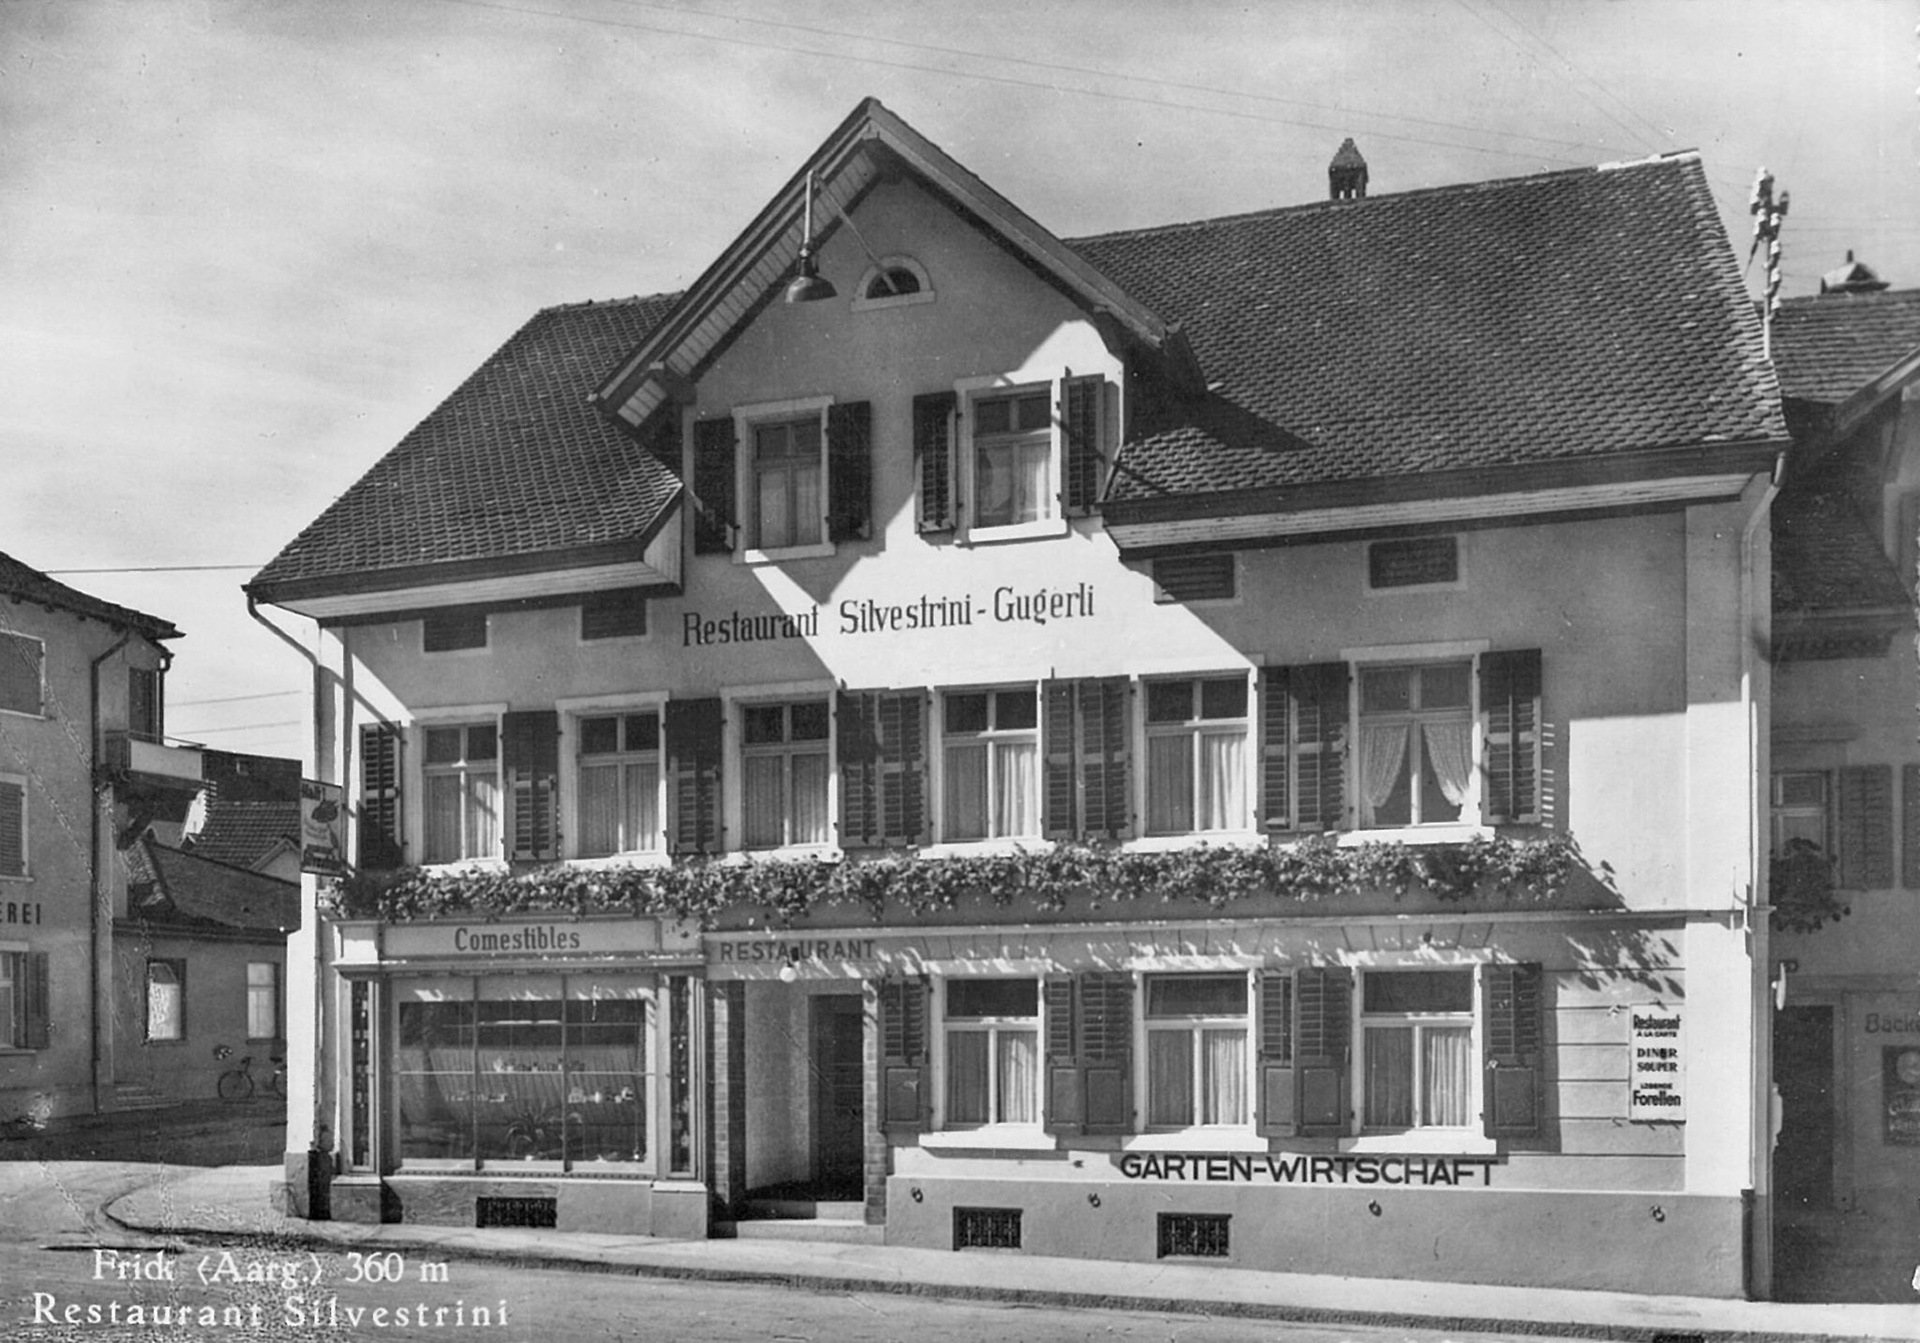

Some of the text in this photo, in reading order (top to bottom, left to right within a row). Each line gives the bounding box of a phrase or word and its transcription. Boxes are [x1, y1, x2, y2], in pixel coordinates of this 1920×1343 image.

[682, 603, 819, 647] Restaurant
[0, 902, 41, 925] REI
[454, 926, 581, 951] Comestibles
[720, 939, 876, 961] RESTAURANT
[1637, 1062, 1678, 1072] SOUPER
[1633, 1090, 1681, 1106] Forellen
[1120, 1154, 1499, 1185] GARTEN-WIRTSCHAFT
